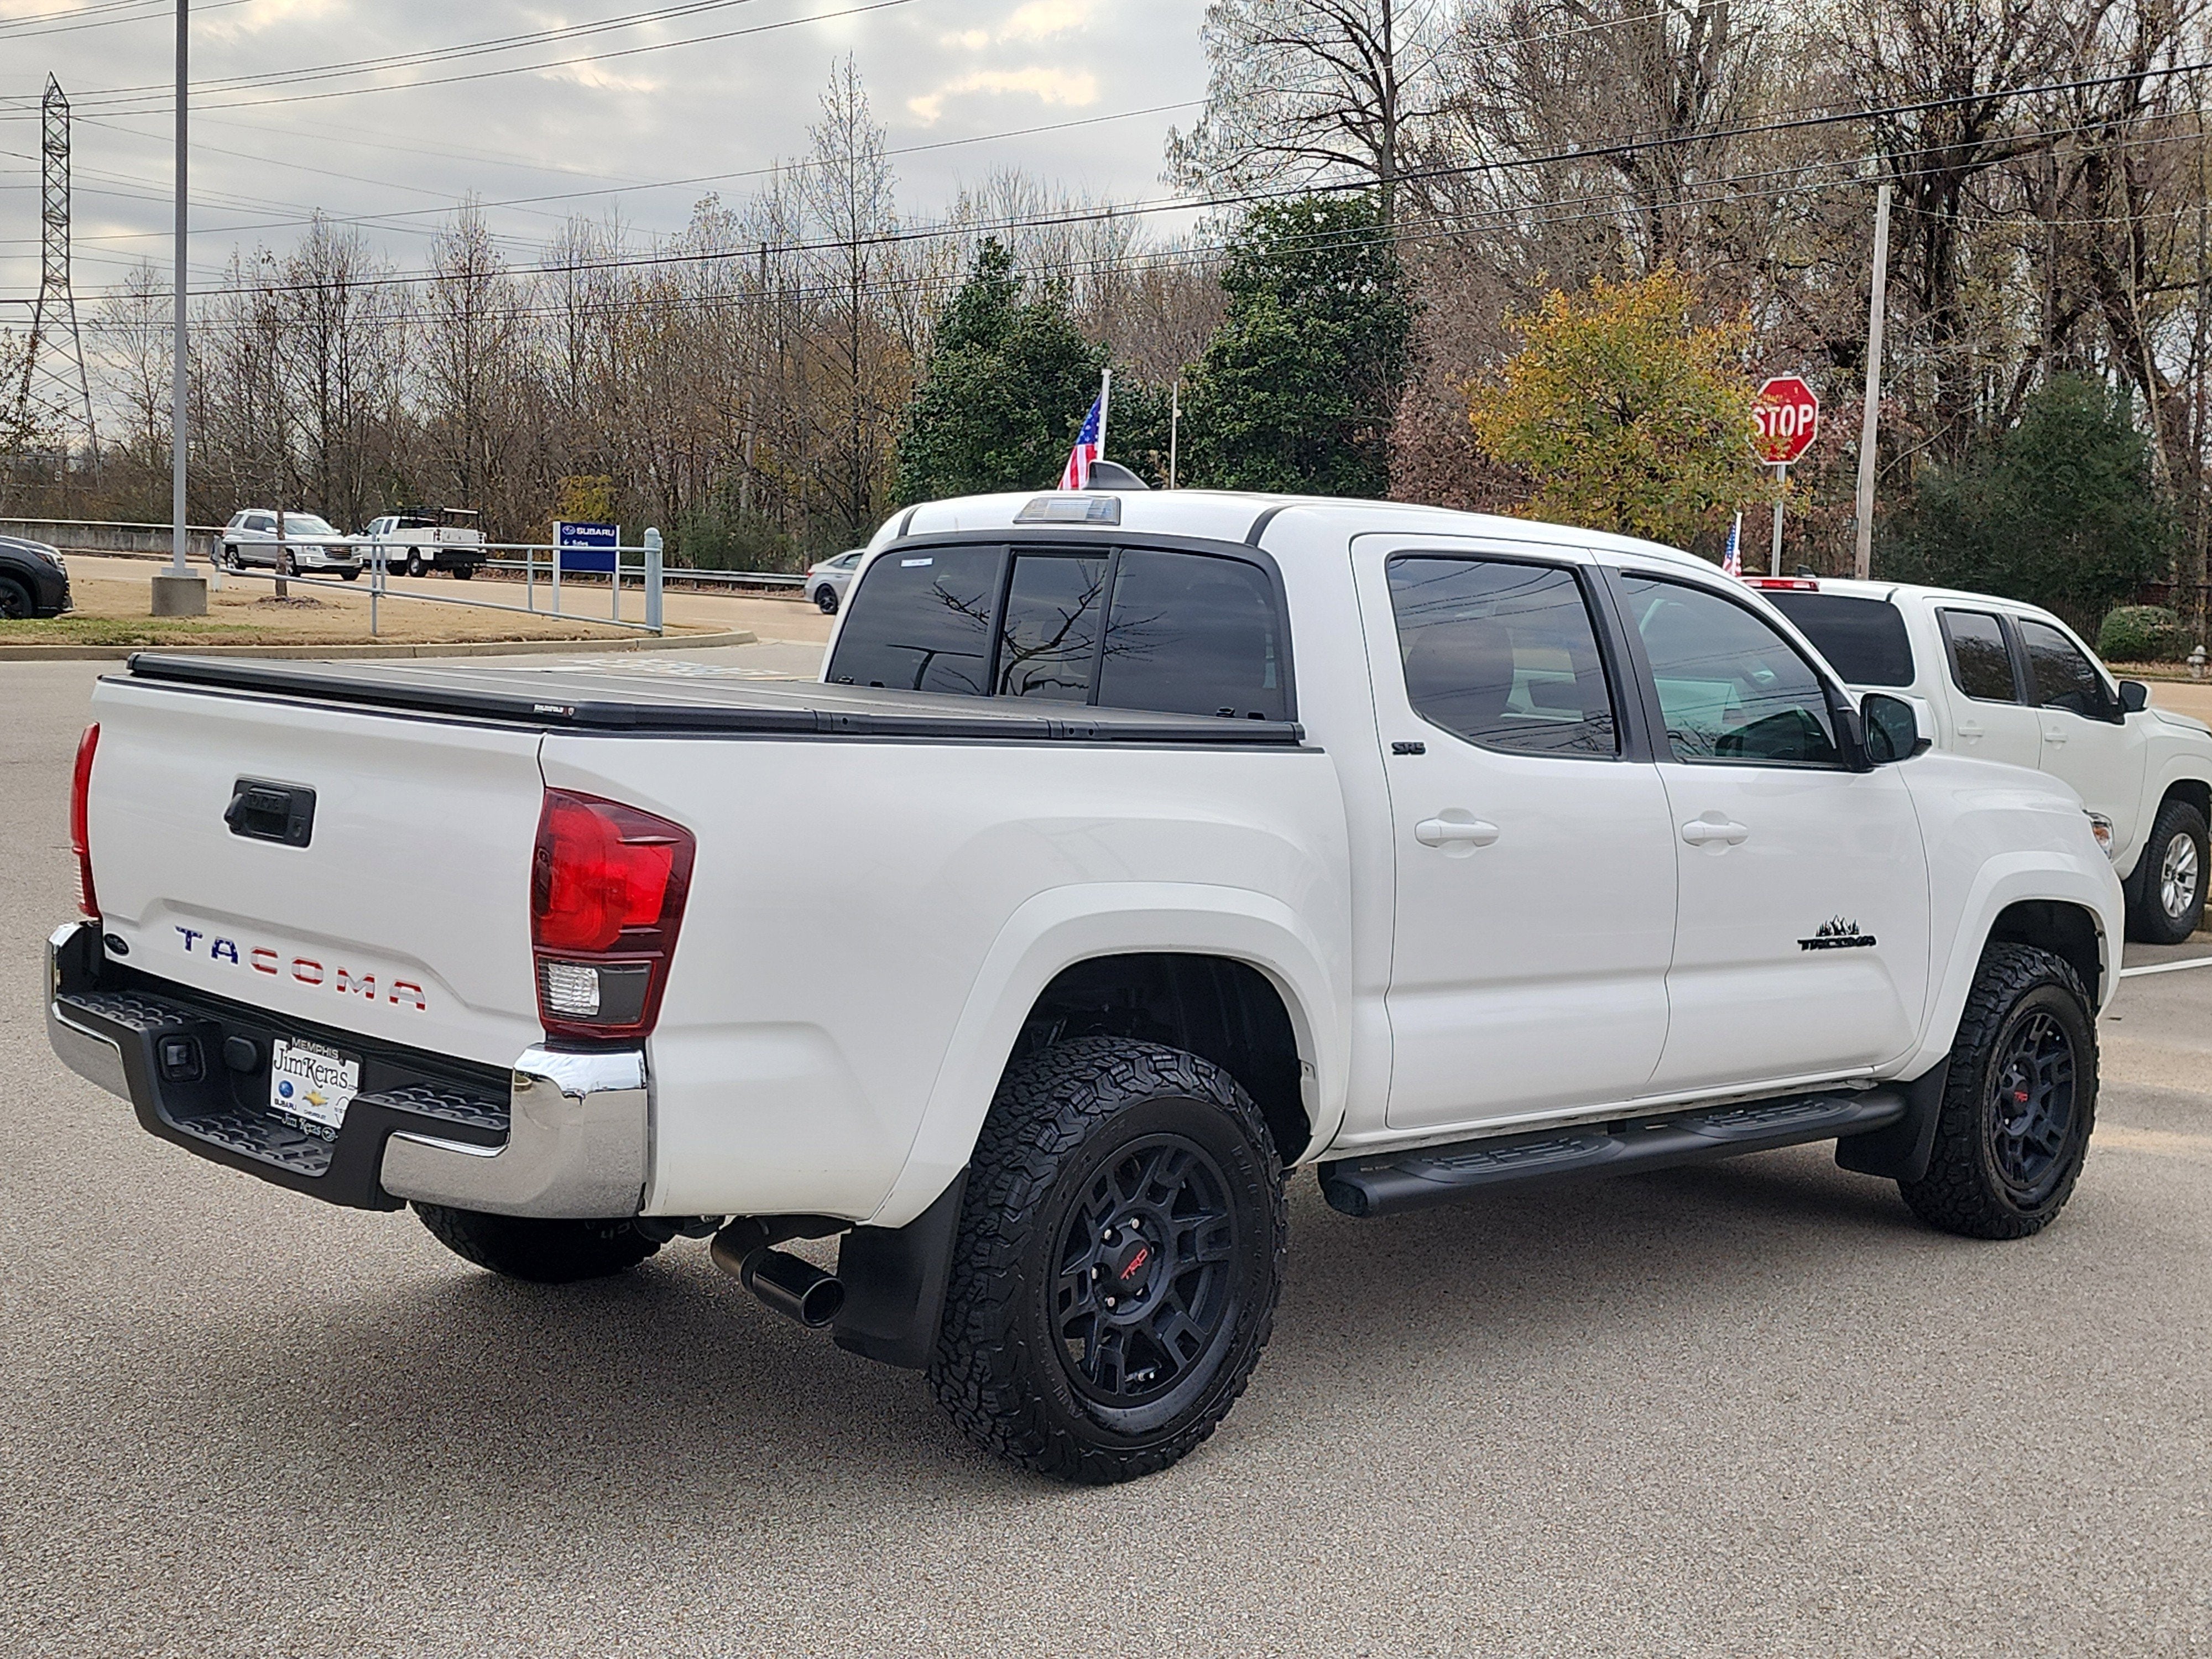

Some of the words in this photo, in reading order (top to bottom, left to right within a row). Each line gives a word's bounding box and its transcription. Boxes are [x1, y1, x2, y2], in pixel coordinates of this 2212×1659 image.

[1752, 404, 1814, 437] STOP
[576, 527, 615, 537] SUBARU
[1797, 935, 1877, 951] TACOMA
[174, 925, 426, 1011] TACOMA
[292, 1037, 339, 1060] MEMPHIS
[281, 1113, 298, 1128] Jim
[1120, 1249, 1148, 1280] TRD
